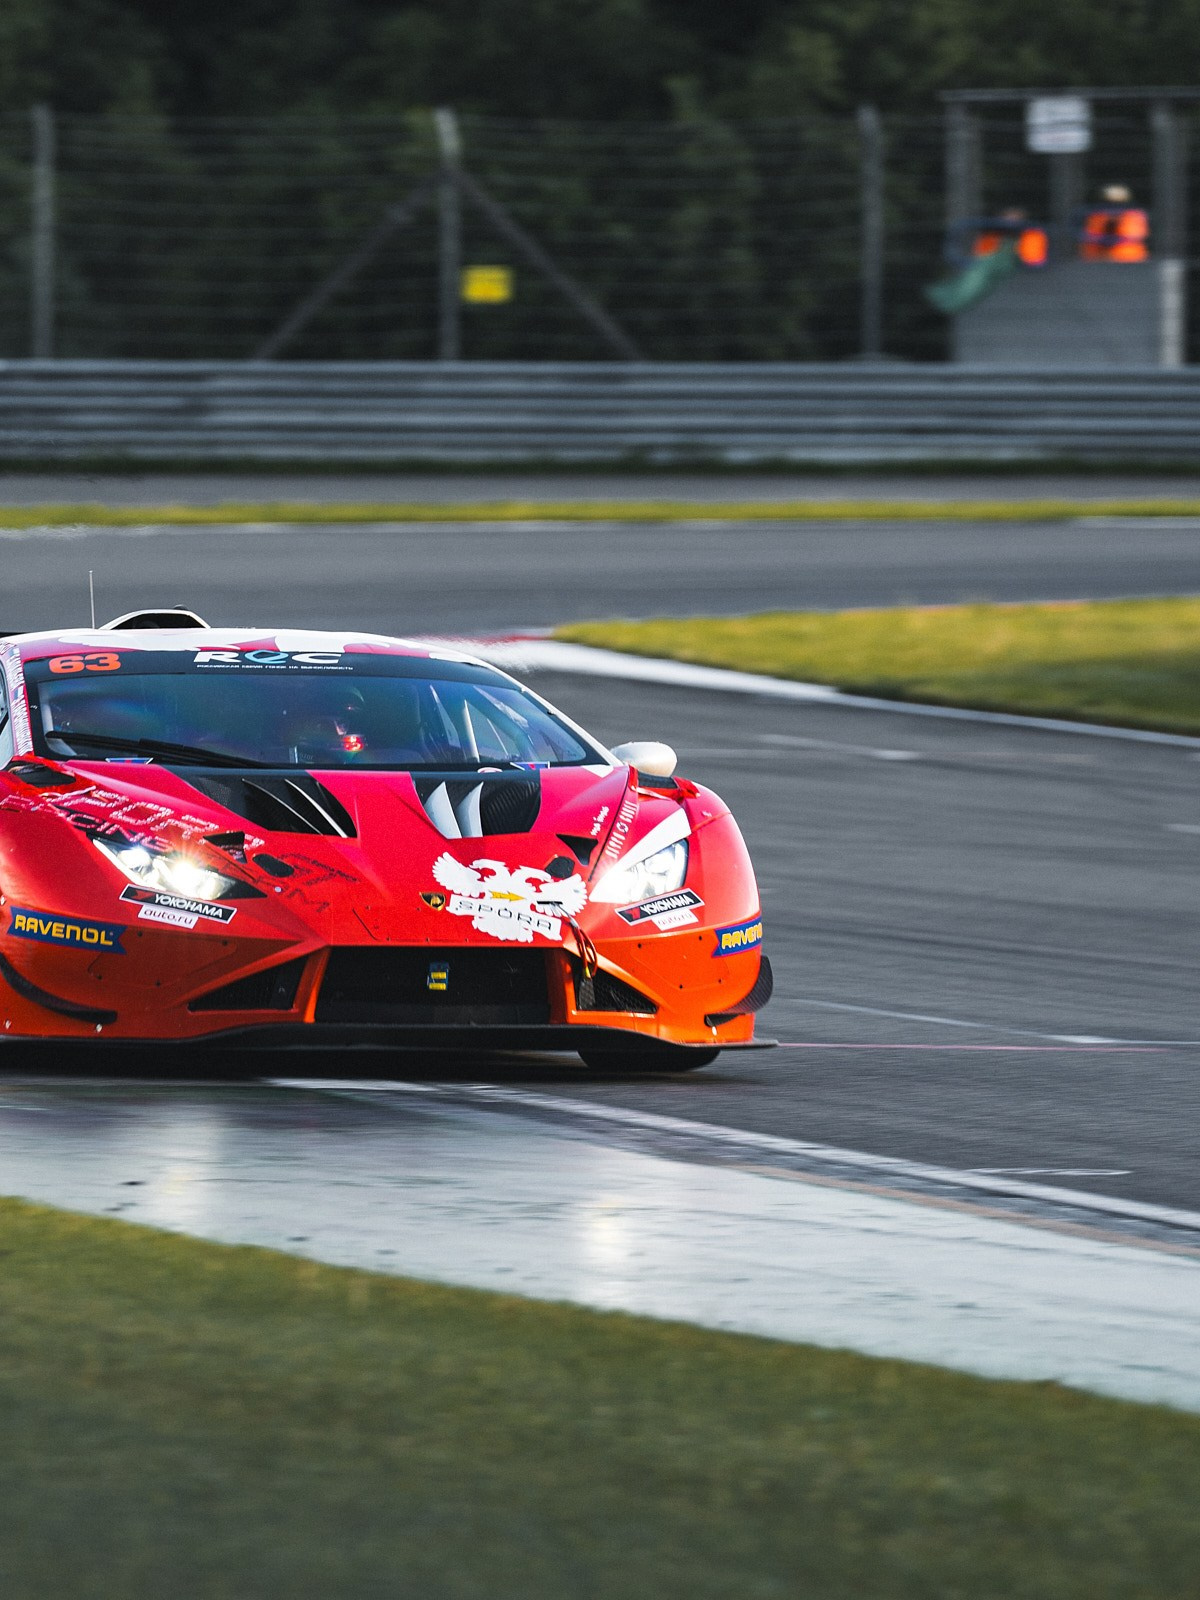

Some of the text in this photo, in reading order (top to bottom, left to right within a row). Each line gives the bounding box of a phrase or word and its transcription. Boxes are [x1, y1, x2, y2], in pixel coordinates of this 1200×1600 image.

[49, 653, 121, 674] 63
[154, 893, 223, 919] YOKOHAMA
[640, 893, 694, 916] YOKOHAMA
[143, 908, 194, 925] auto.ru
[14, 914, 114, 946] RAVENOL
